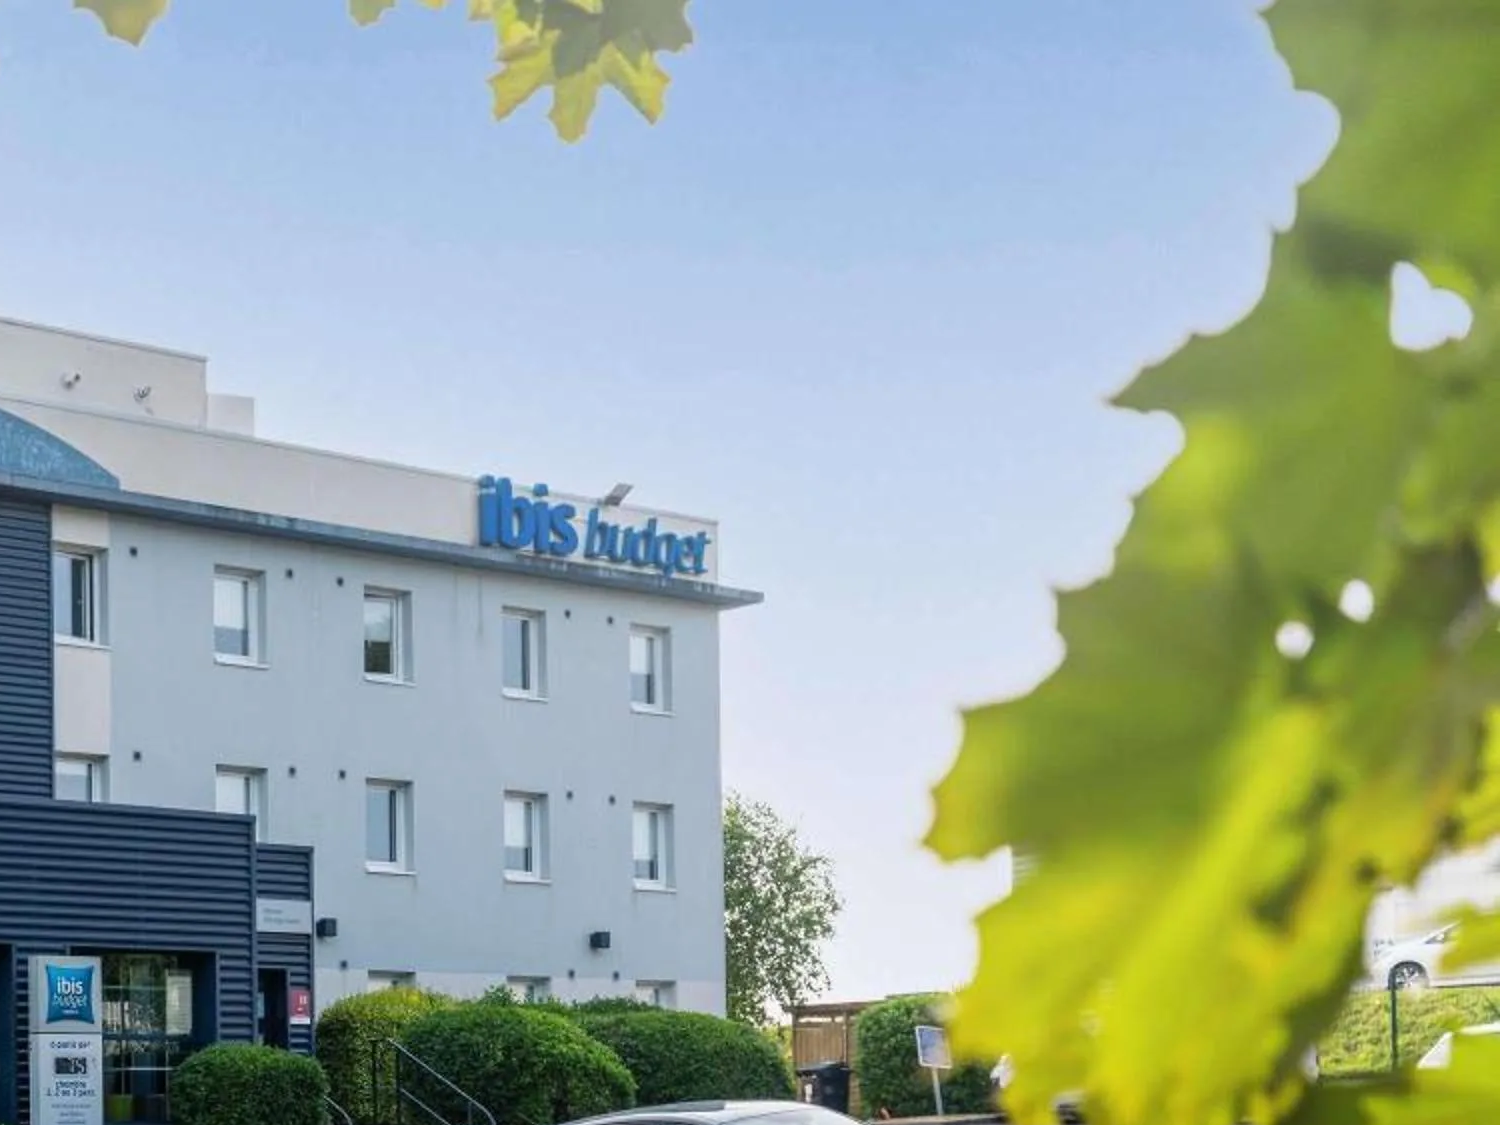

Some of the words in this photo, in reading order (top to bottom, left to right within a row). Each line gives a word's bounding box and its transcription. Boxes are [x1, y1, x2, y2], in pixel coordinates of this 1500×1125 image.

[478, 474, 579, 557] ibis
[584, 507, 711, 581] budget
[57, 976, 84, 994] ibis
[52, 992, 88, 1009] budget
